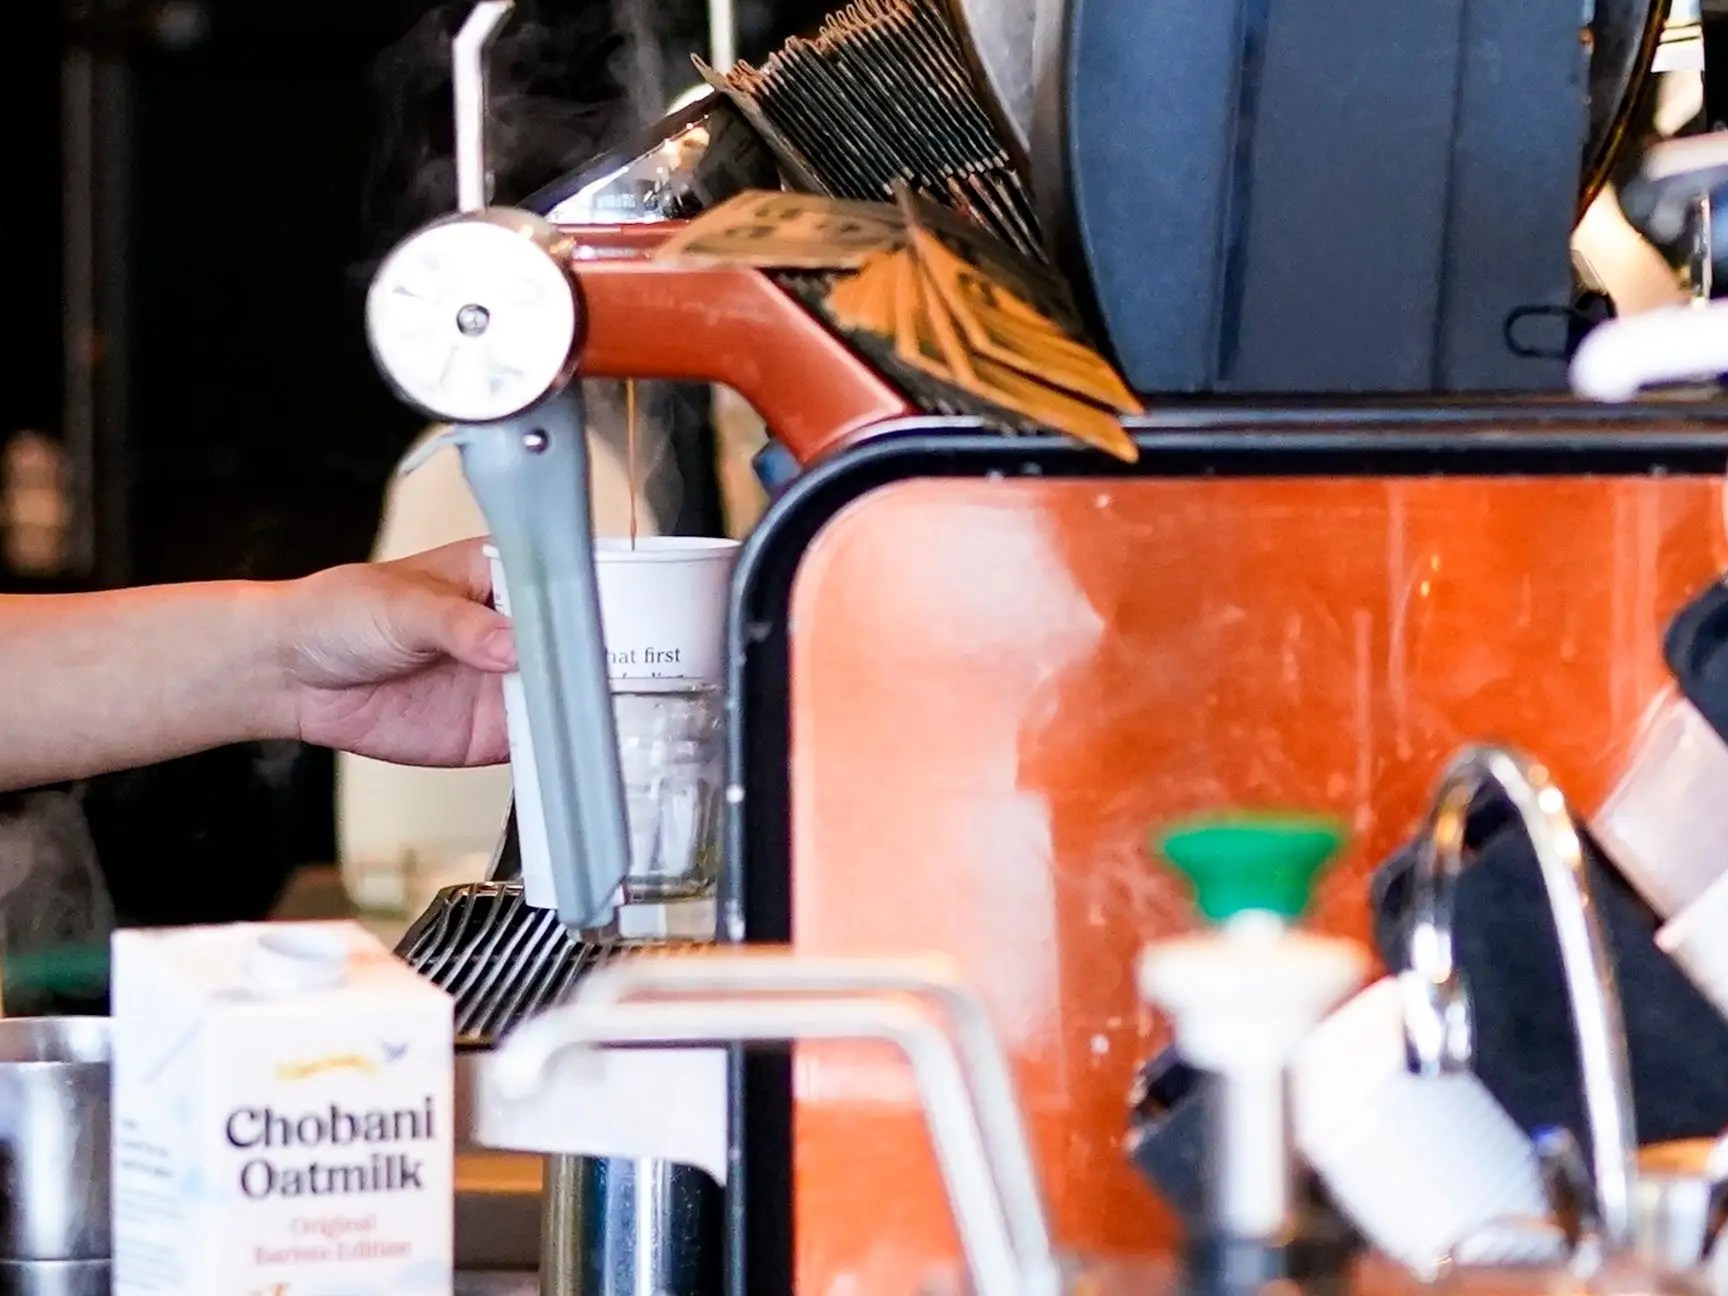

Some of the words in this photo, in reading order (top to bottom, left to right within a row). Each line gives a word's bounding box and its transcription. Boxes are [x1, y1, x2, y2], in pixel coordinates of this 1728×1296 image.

[644, 646, 681, 664] first
[225, 1095, 434, 1148] Chobani
[240, 1153, 423, 1201] Oatmilk
